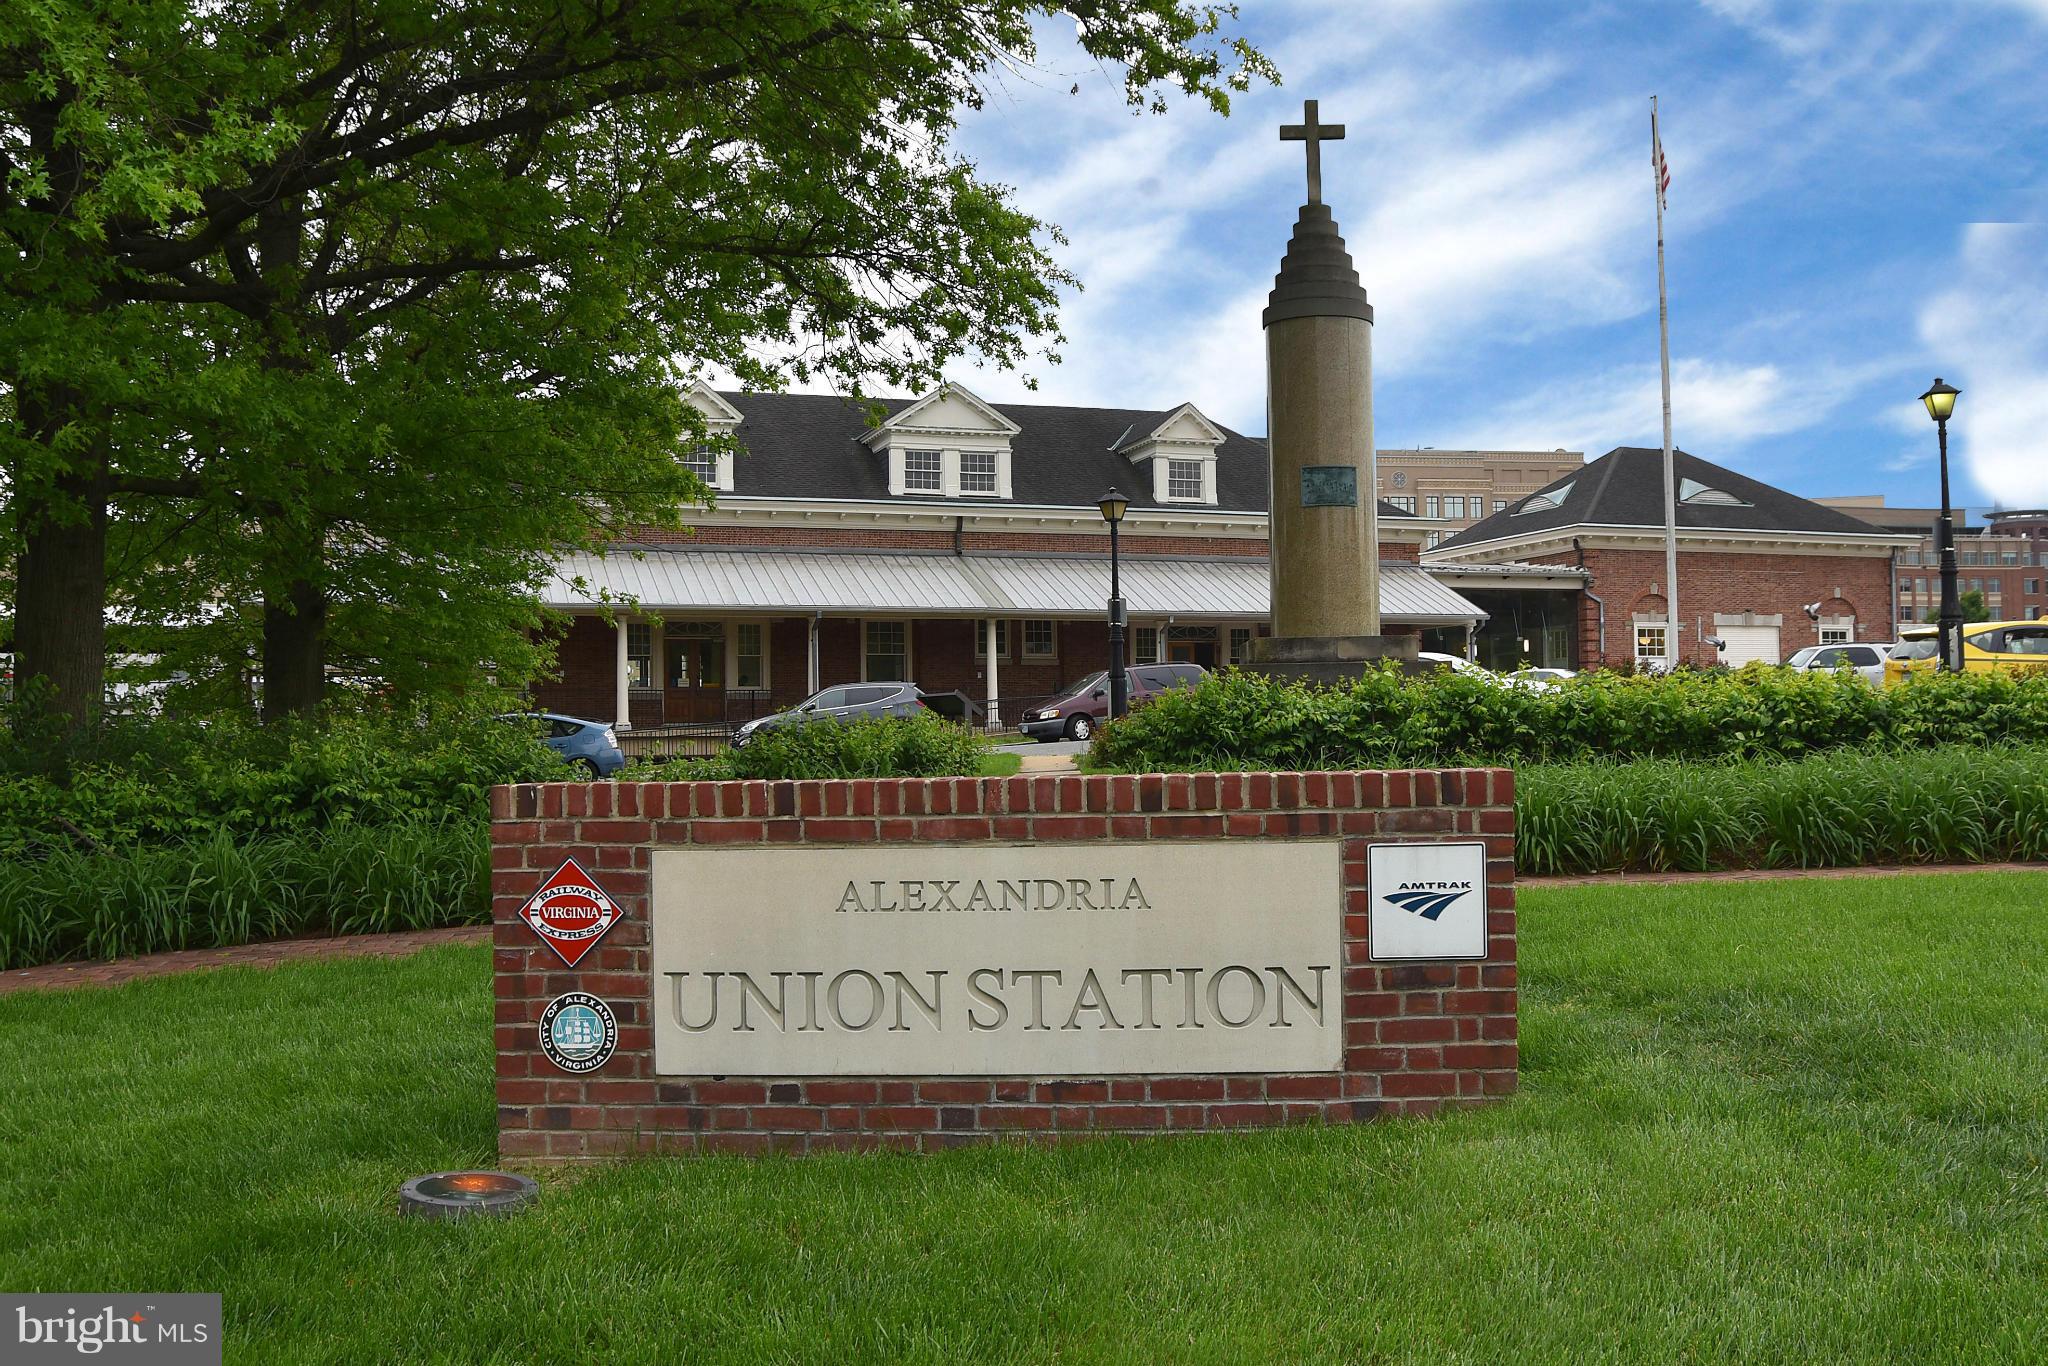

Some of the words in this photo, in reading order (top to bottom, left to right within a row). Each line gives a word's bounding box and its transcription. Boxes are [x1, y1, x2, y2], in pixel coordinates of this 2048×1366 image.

[1398, 881, 1472, 890] AMTRAK
[538, 886, 604, 902] RAILWAY
[835, 877, 1152, 913] ALEXANDRIA
[541, 906, 601, 919] VIRGINIA
[538, 922, 604, 939] EXPRESS
[663, 968, 949, 1034] UNION
[966, 965, 1331, 1032] STATION
[546, 1003, 559, 1018] OF
[565, 995, 614, 1049] ALEXANDRIA
[542, 1021, 552, 1049] CITY
[555, 1054, 604, 1070] VIRGINIA
